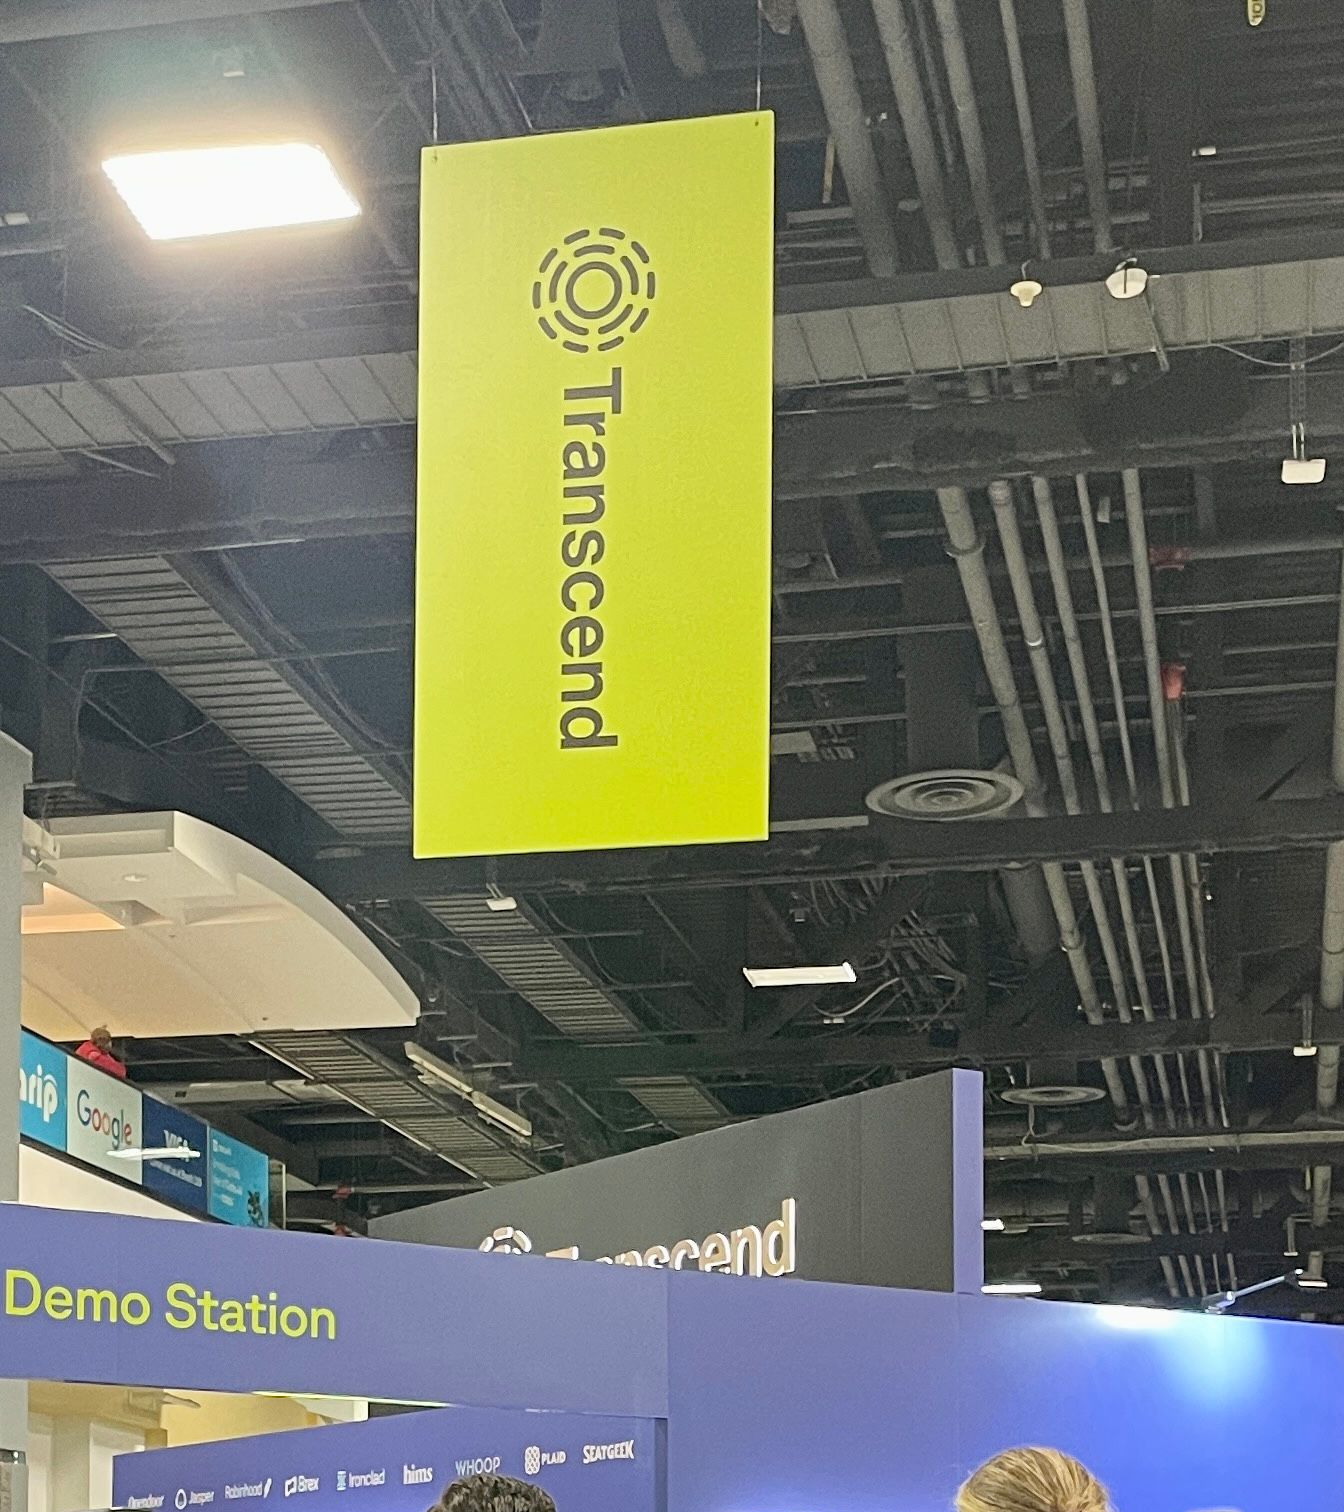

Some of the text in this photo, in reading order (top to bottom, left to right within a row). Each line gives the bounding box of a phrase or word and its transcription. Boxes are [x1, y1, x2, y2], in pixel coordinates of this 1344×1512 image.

[558, 366, 623, 751] Transcend
[77, 1089, 133, 1150] Google
[5, 1269, 151, 1325] Demo
[165, 1282, 337, 1341] Station
[541, 1451, 567, 1466] PLAID
[582, 1439, 635, 1465] SEATGEEK
[403, 1464, 434, 1485] hims
[455, 1456, 501, 1477] WHOOP
[297, 1475, 320, 1493] Brex
[348, 1468, 386, 1488] Ironclad
[224, 1481, 263, 1499] Robinhood
